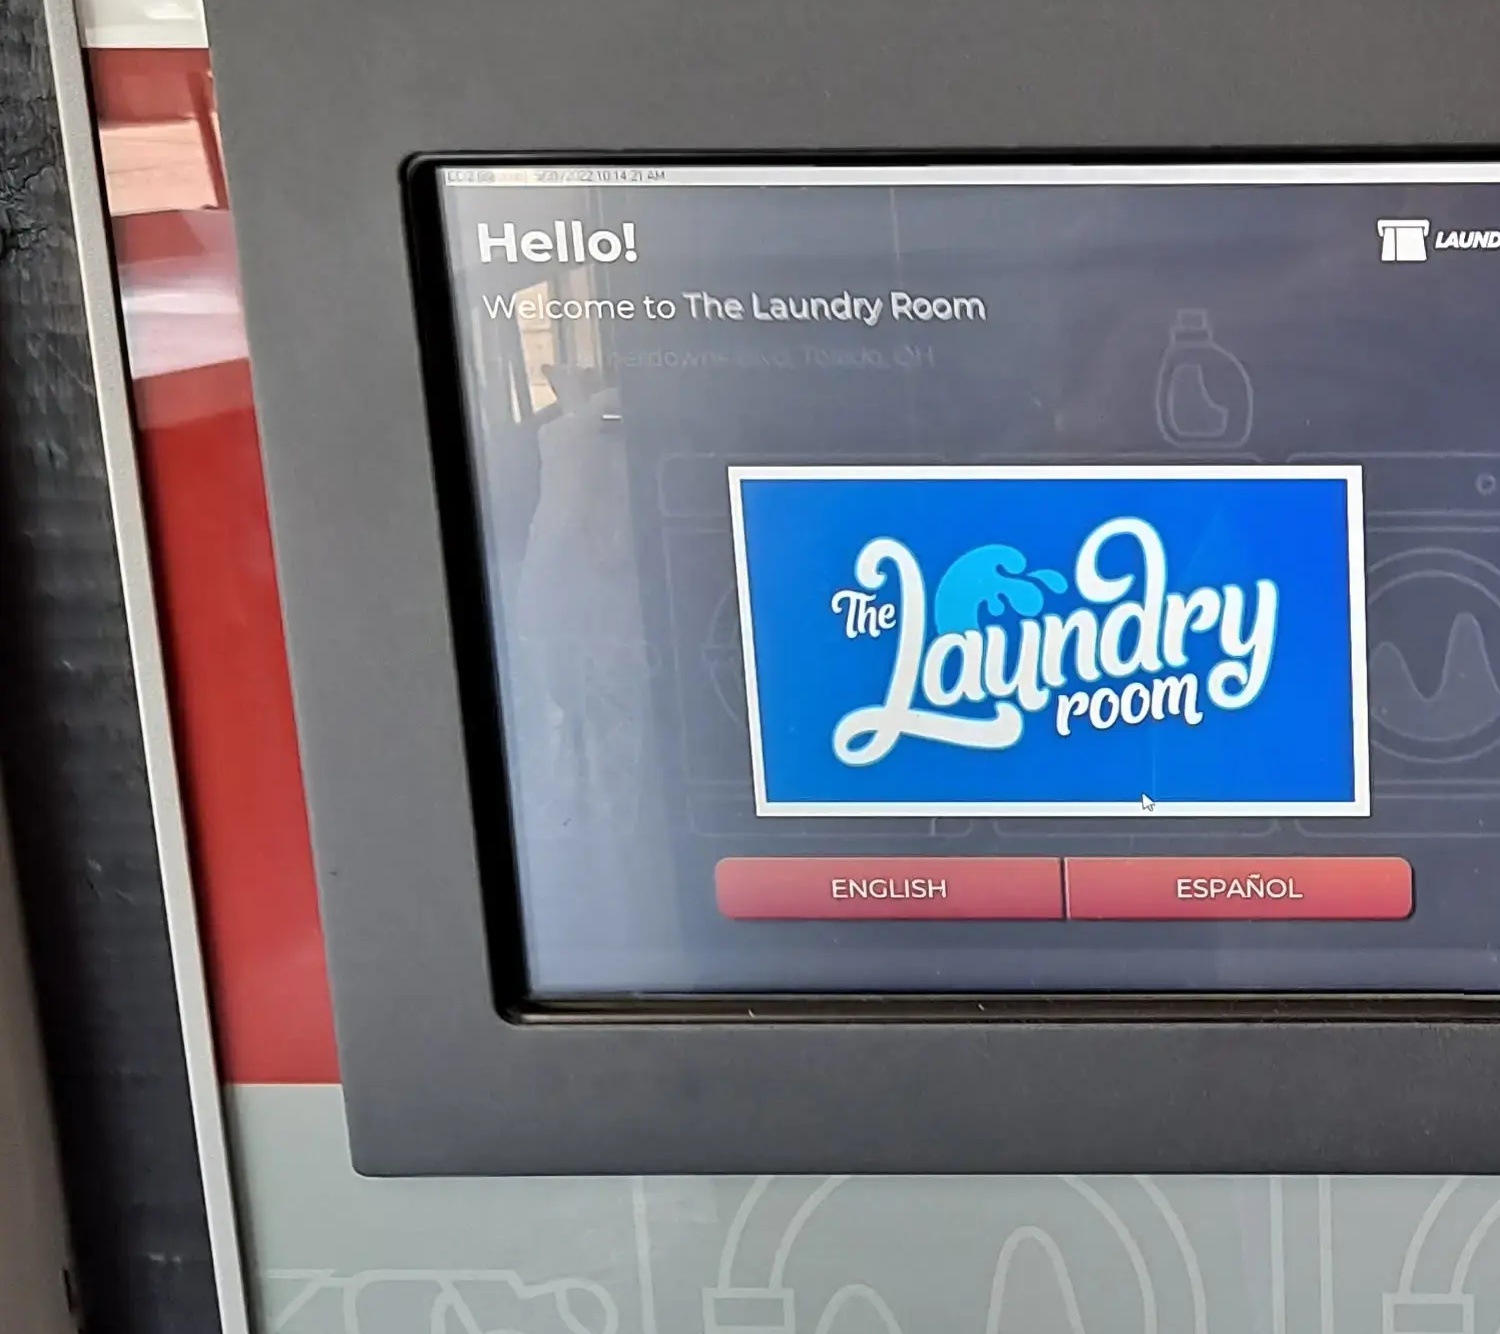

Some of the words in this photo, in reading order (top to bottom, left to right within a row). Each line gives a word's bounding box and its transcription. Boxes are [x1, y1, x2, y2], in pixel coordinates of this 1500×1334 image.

[477, 221, 637, 263] Hello!
[482, 294, 635, 320] Welcome
[643, 295, 676, 319] to
[683, 292, 745, 321] The
[751, 292, 882, 327] Laundry
[891, 292, 987, 321] Room
[831, 588, 896, 639] The
[832, 515, 1279, 767] Laundry
[1055, 673, 1202, 736] room
[831, 878, 947, 898] ENGLISH
[1177, 873, 1304, 898] ESPAÑOL
